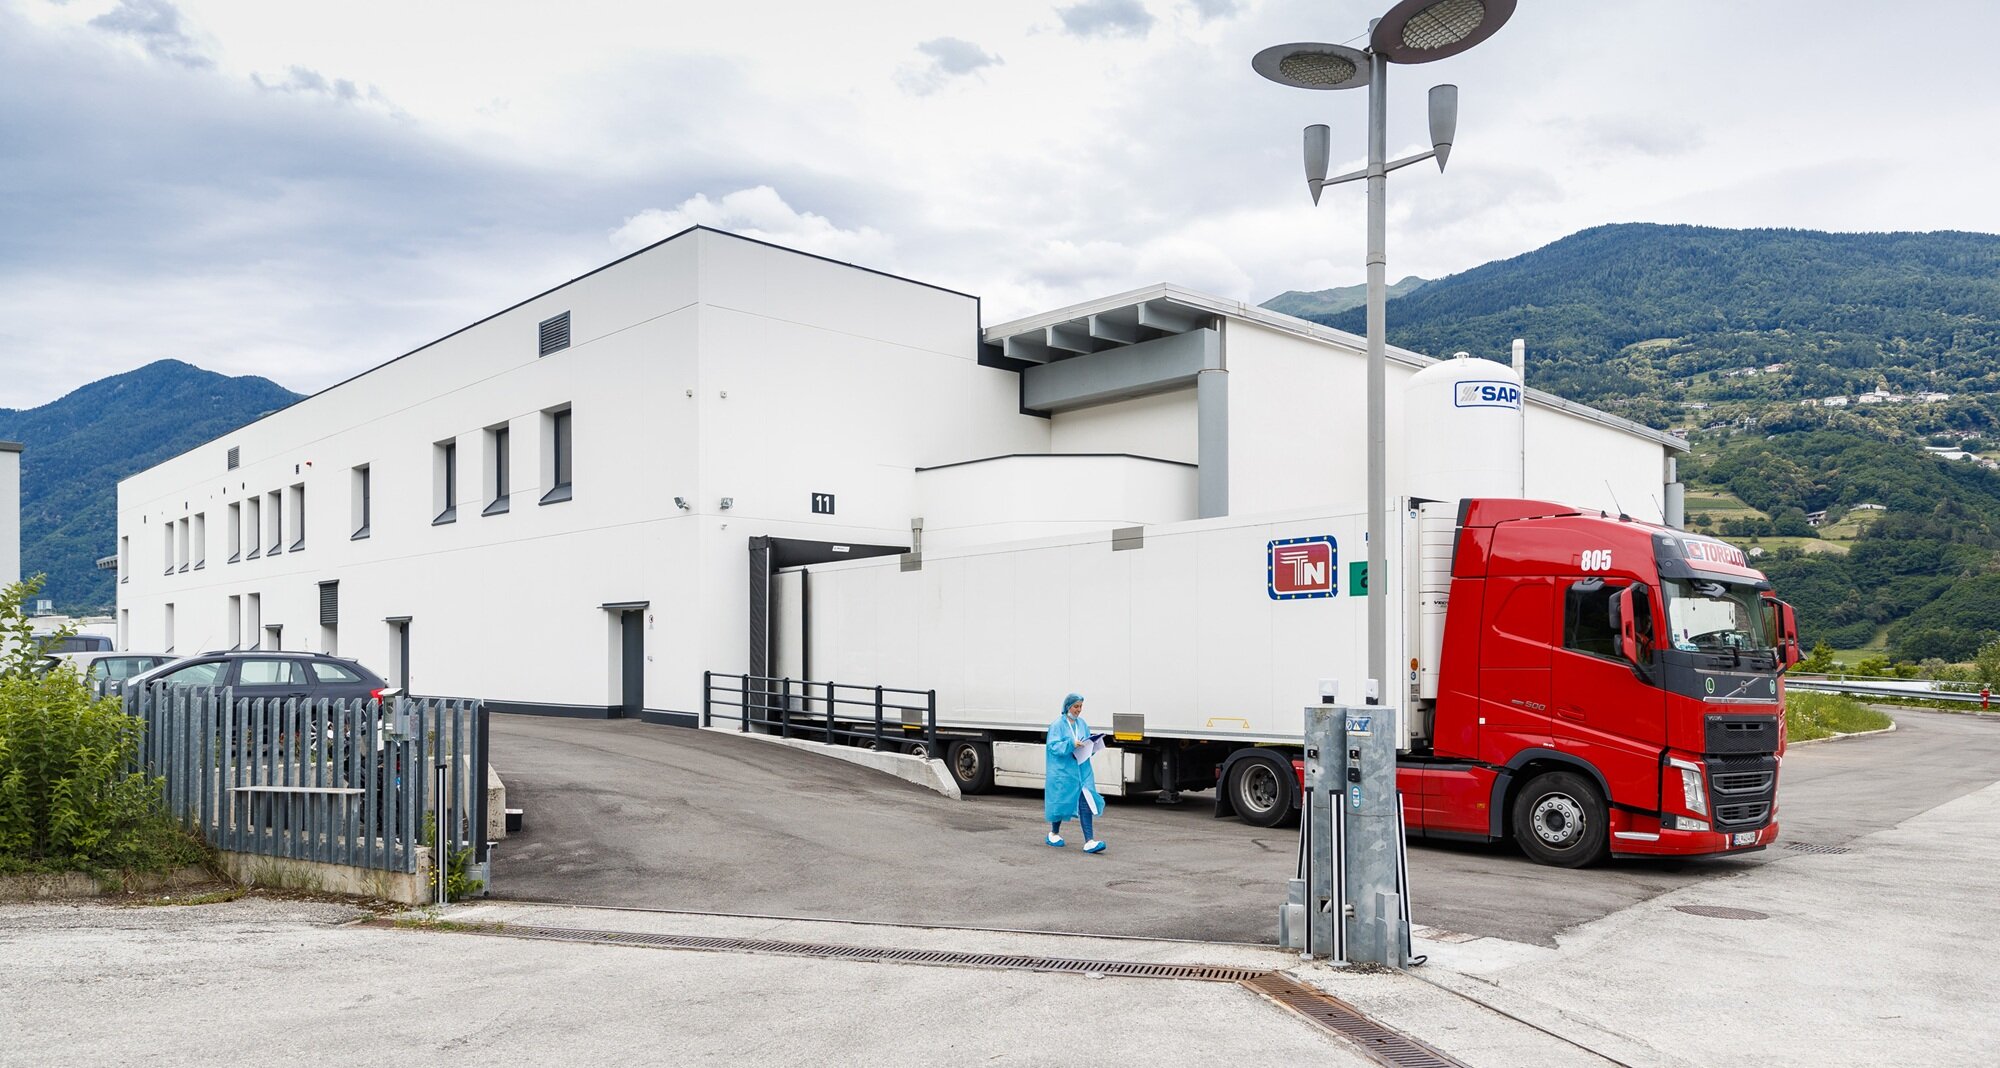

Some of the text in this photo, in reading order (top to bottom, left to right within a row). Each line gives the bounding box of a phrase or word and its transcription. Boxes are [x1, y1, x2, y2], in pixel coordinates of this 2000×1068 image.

[816, 495, 830, 512] 11
[1581, 550, 1612, 571] 805
[1702, 543, 1745, 568] TORELLO
[1280, 551, 1325, 586] TN
[1525, 700, 1546, 711] 500
